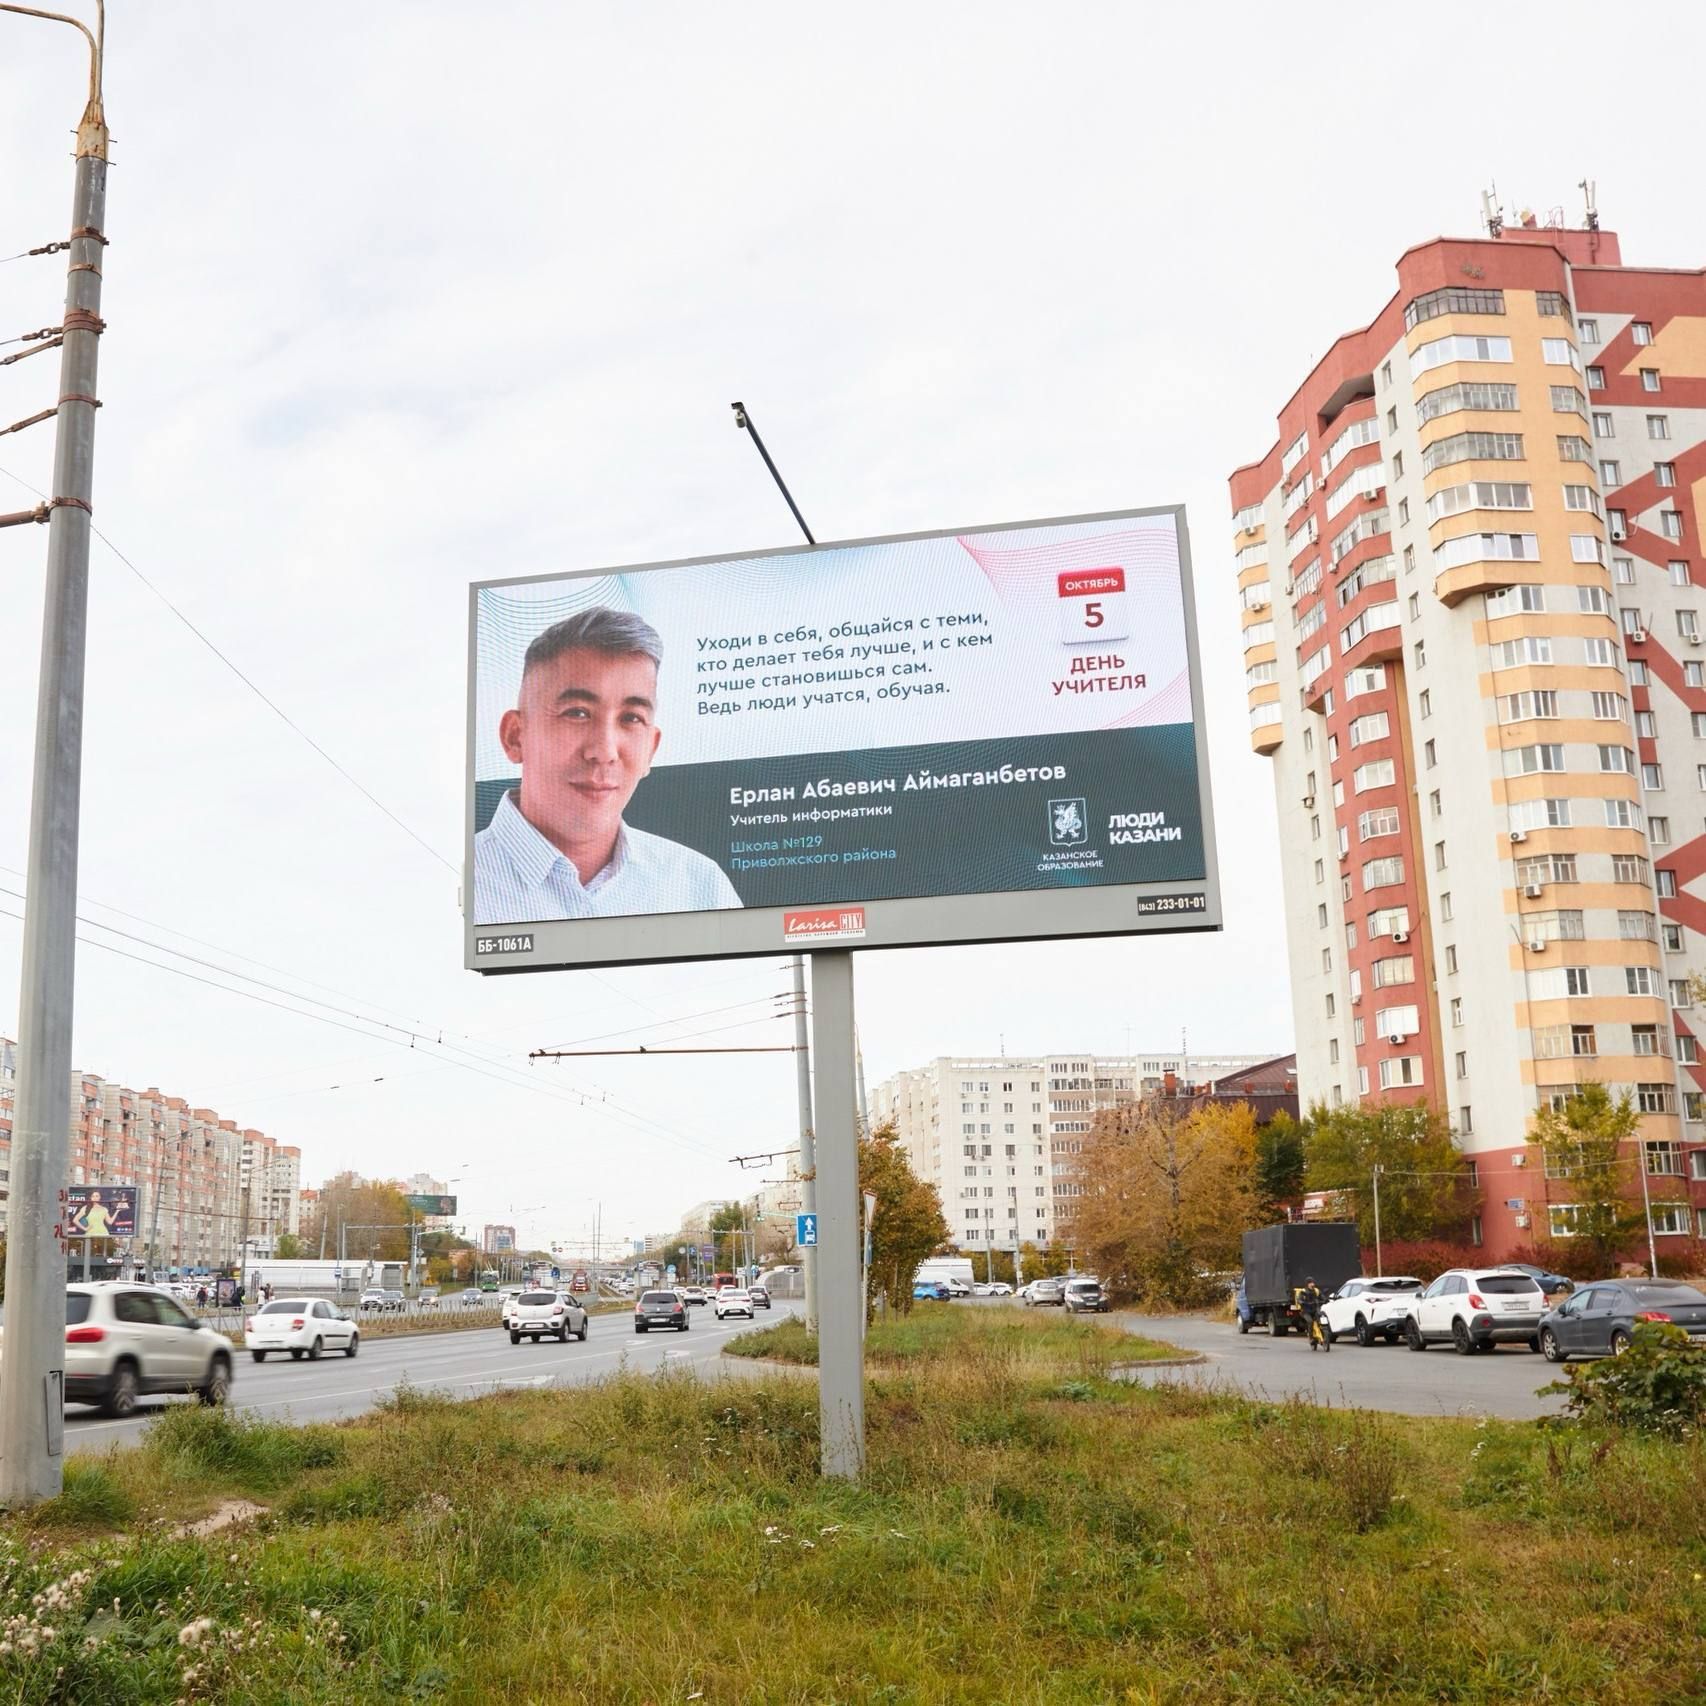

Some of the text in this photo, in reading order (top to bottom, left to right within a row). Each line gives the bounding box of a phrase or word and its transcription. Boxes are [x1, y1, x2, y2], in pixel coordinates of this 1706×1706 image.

[1065, 577, 1118, 591] ОКТЯБРЬ
[1085, 602, 1104, 628] 5
[697, 613, 988, 652] Уходи в себя, общайся с теми,
[697, 634, 992, 672] кто делает тебя лучше, и с кем
[1071, 654, 1125, 675] ДЕНЬ
[697, 662, 932, 696] лучше становишься сам.
[1052, 674, 1146, 696] УЧИТЕЛЯ
[698, 682, 950, 716] Ведь люди учатся, обучая.
[730, 764, 1066, 807] Ерлан Абаевич Аймаганбетов
[730, 805, 893, 826] Учитель информатики
[1108, 812, 1165, 829] ЛЮДИ
[731, 835, 823, 853] Школа №129
[1110, 827, 1182, 845] КАЗАНИ
[731, 848, 897, 871] Приволжского района
[1037, 859, 1104, 871] ОБРАЗОВАНИЕ
[1042, 850, 1098, 861] КАЗАНСКОЕ
[1156, 896, 1205, 911] 233-01-01
[788, 918, 838, 932] Larisa
[478, 937, 532, 953] ББ-1061А
